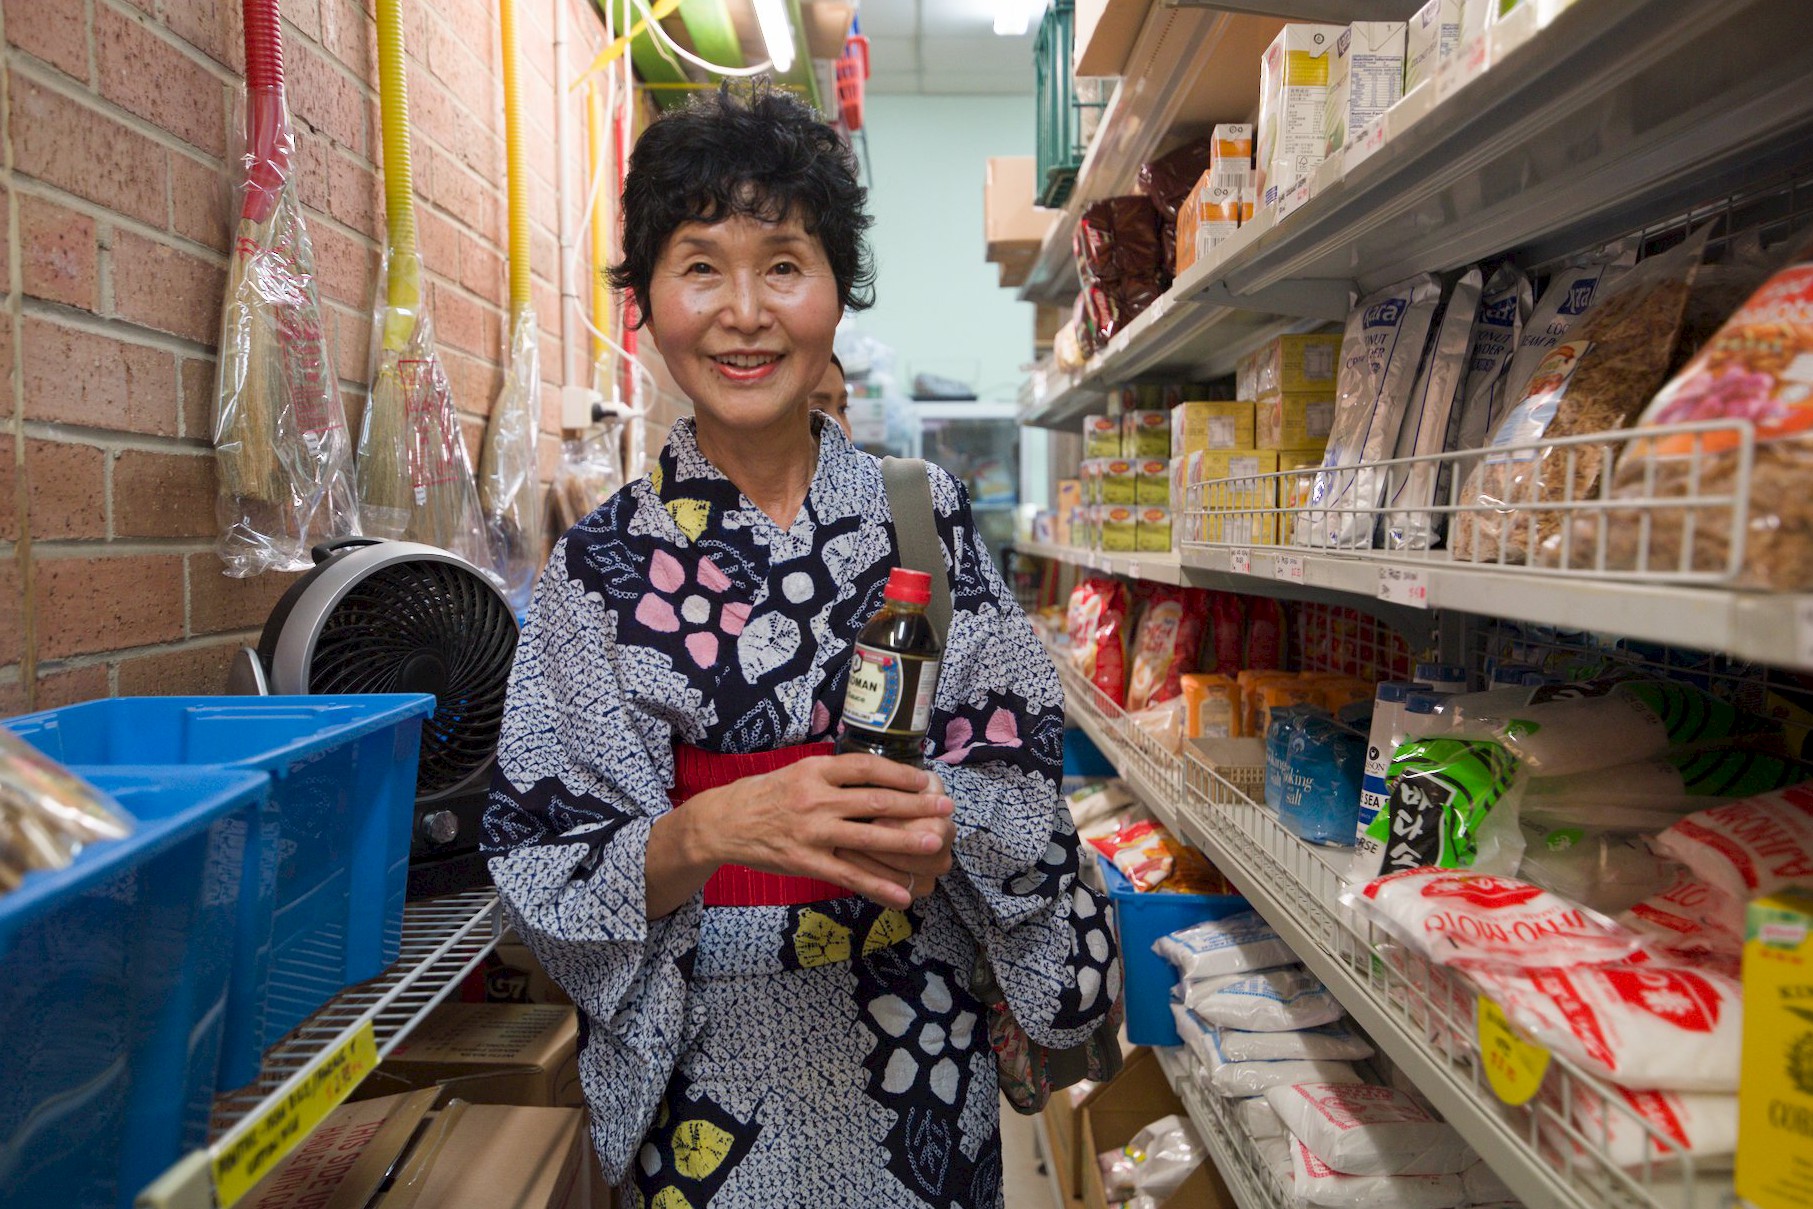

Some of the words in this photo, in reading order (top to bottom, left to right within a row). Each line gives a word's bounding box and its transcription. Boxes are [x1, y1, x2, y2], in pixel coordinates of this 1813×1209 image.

[1364, 793, 1380, 808] SEA
[338, 1117, 386, 1151] THIS
[307, 1151, 362, 1190] SIDE
